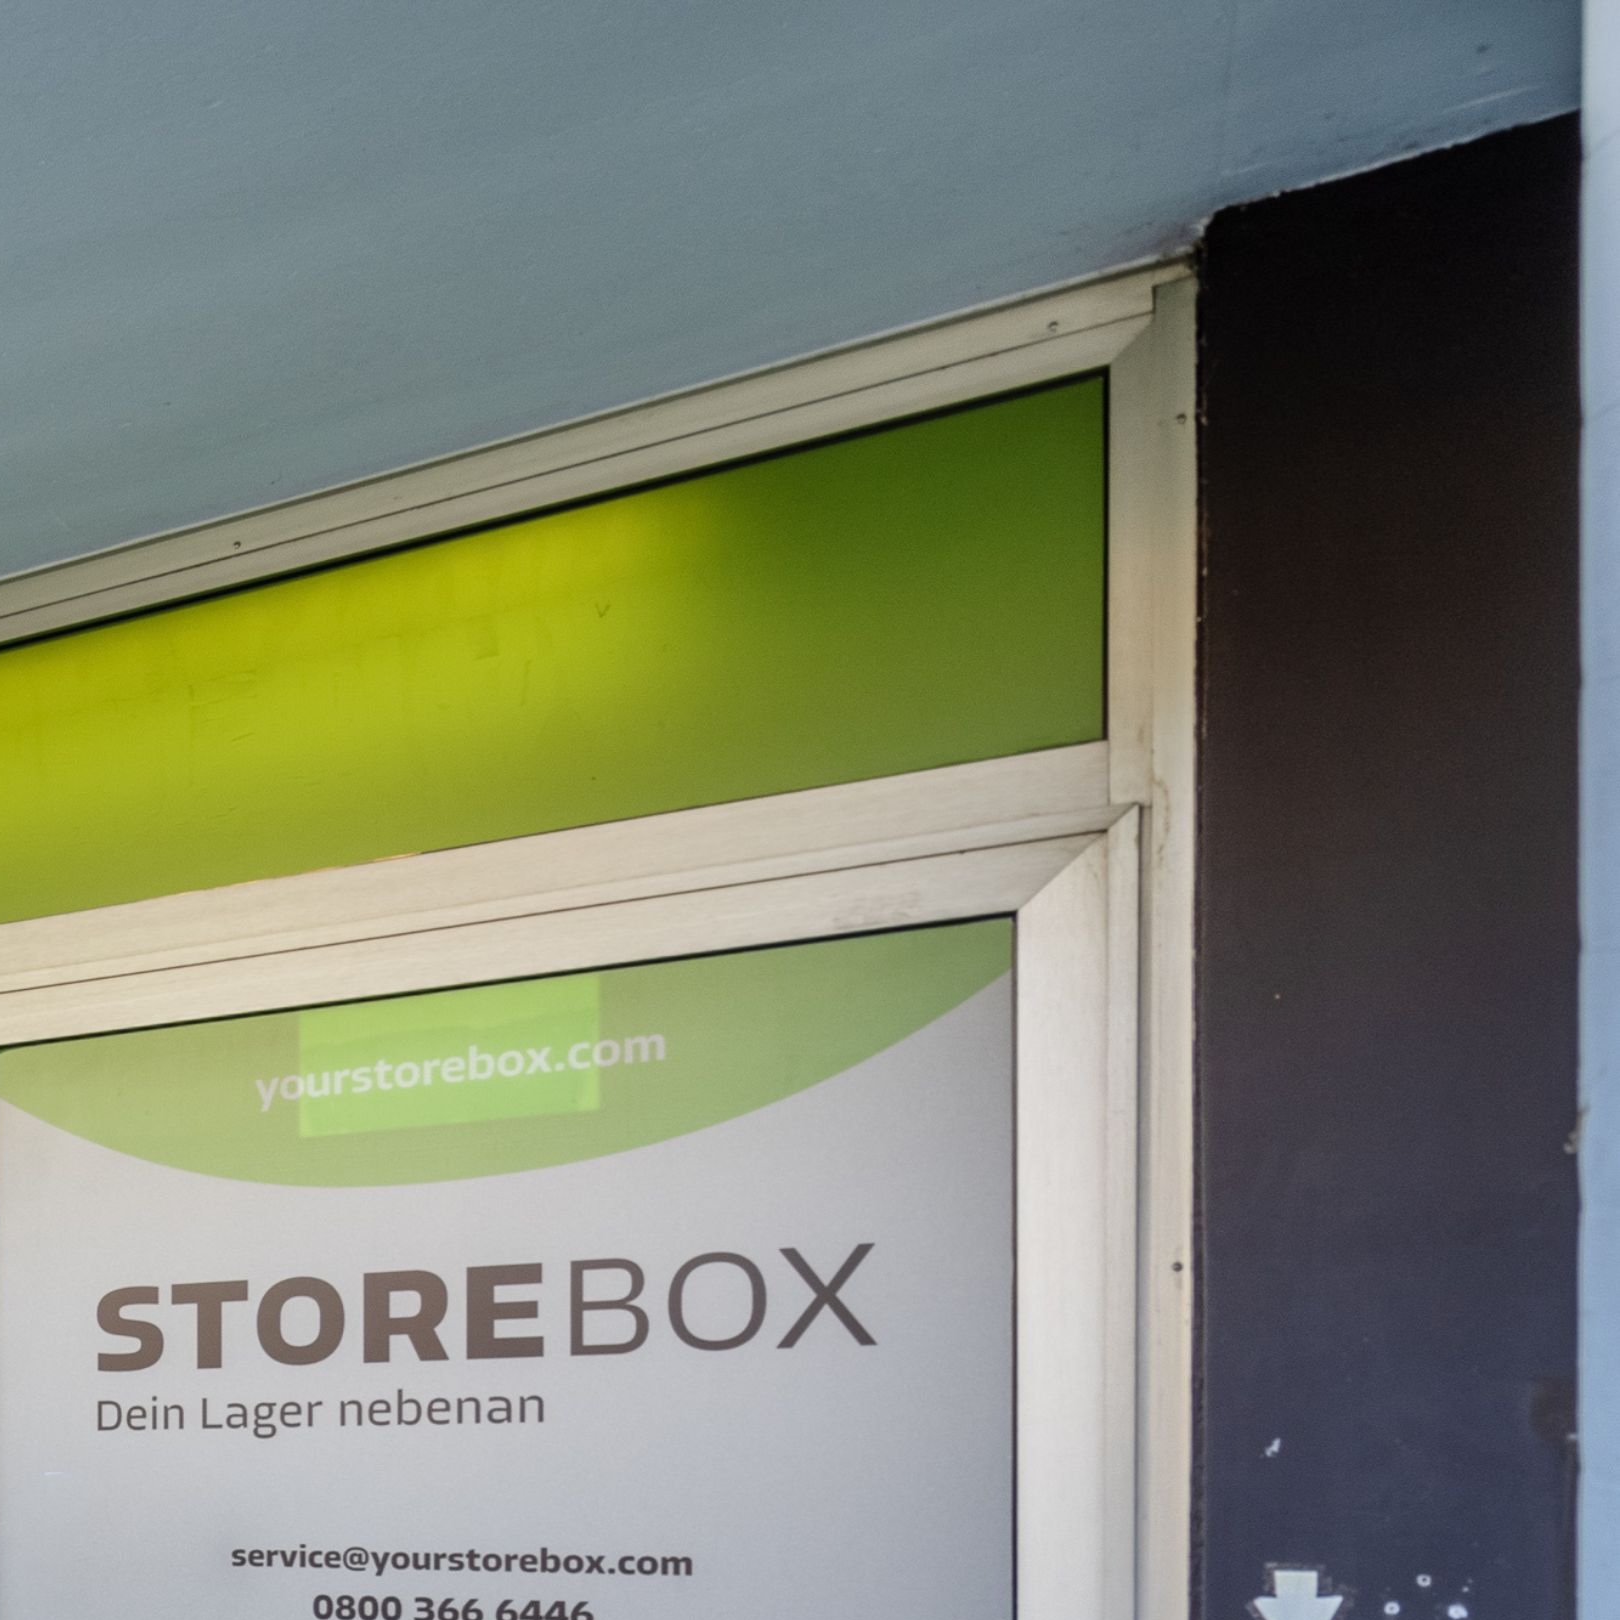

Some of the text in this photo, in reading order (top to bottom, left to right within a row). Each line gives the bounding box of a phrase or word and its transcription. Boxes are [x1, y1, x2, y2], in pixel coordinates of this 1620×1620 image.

[254, 1028, 669, 1112] yourstorebox.com
[94, 1240, 881, 1375] STOREBOX
[94, 1388, 547, 1440] Dein Lager nebenan
[230, 1543, 695, 1578] service@yourstorebox.com
